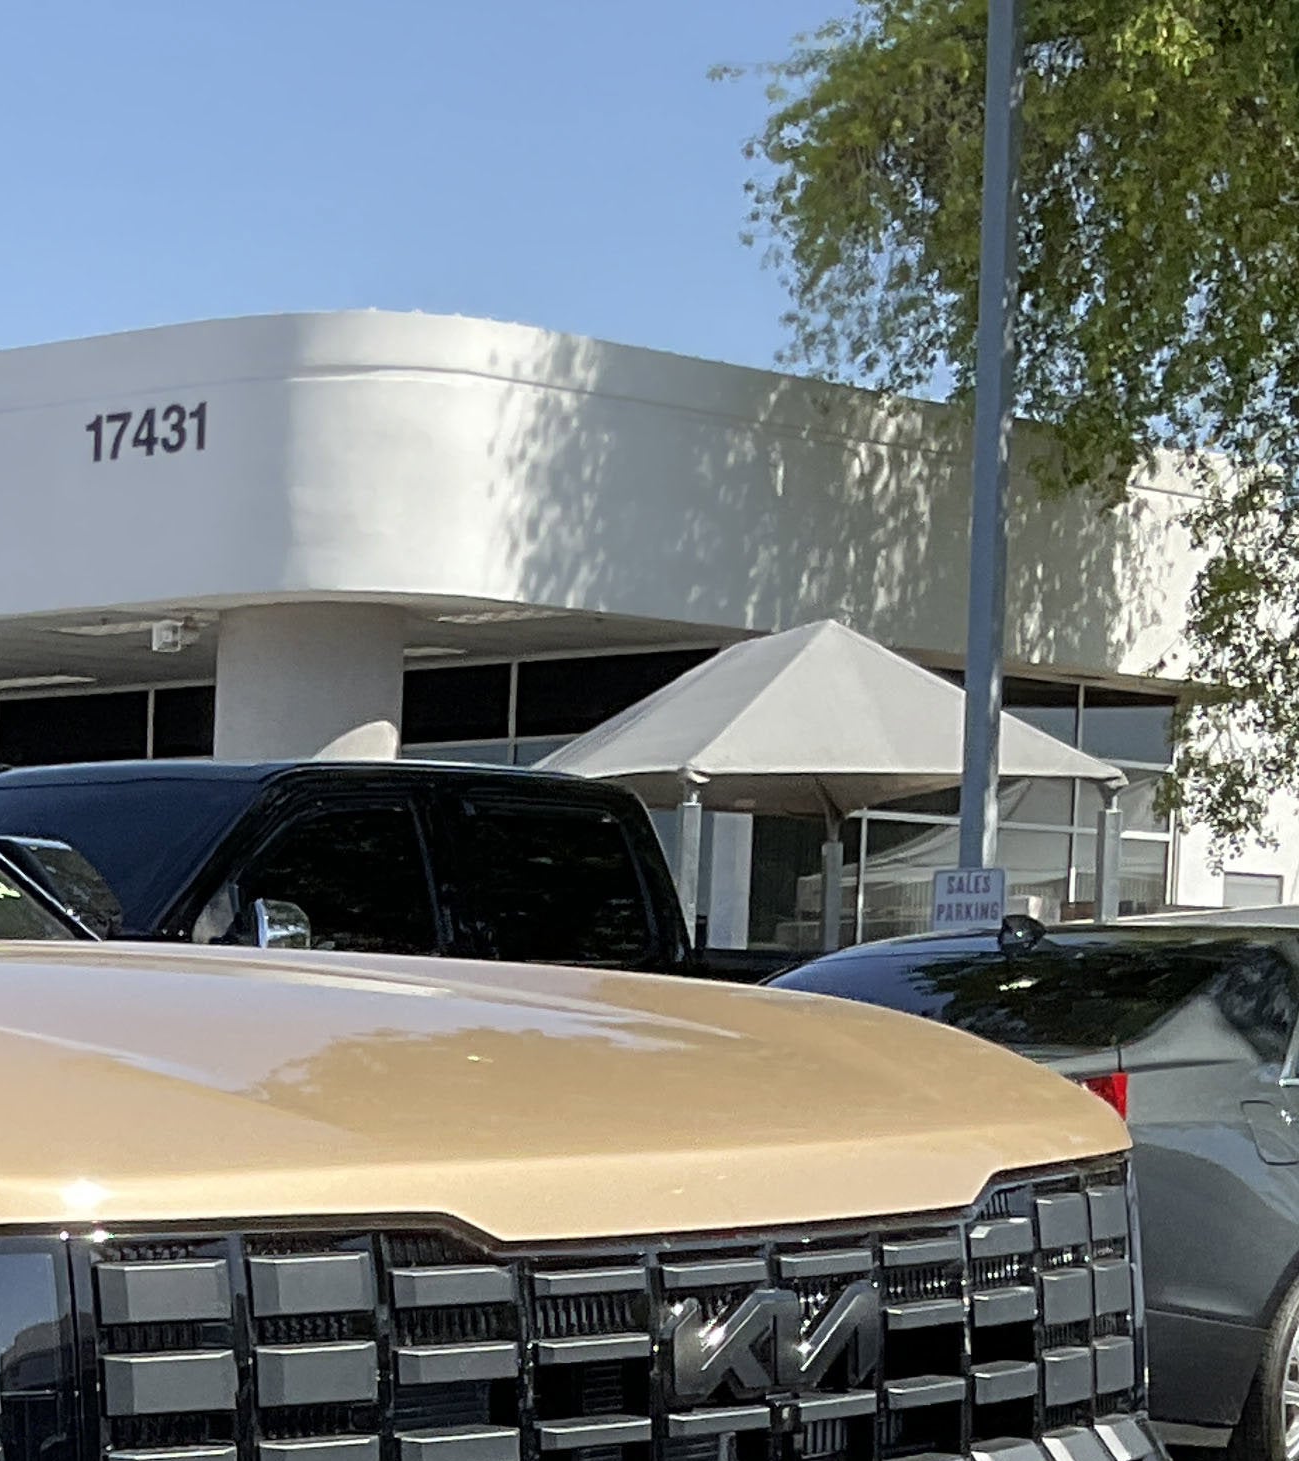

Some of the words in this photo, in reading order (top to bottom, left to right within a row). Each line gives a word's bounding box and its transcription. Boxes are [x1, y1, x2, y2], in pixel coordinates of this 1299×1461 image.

[84, 401, 208, 463] 17431
[946, 875, 992, 894] SALES
[936, 901, 1000, 922] PARKING
[663, 1279, 880, 1397] KIA
